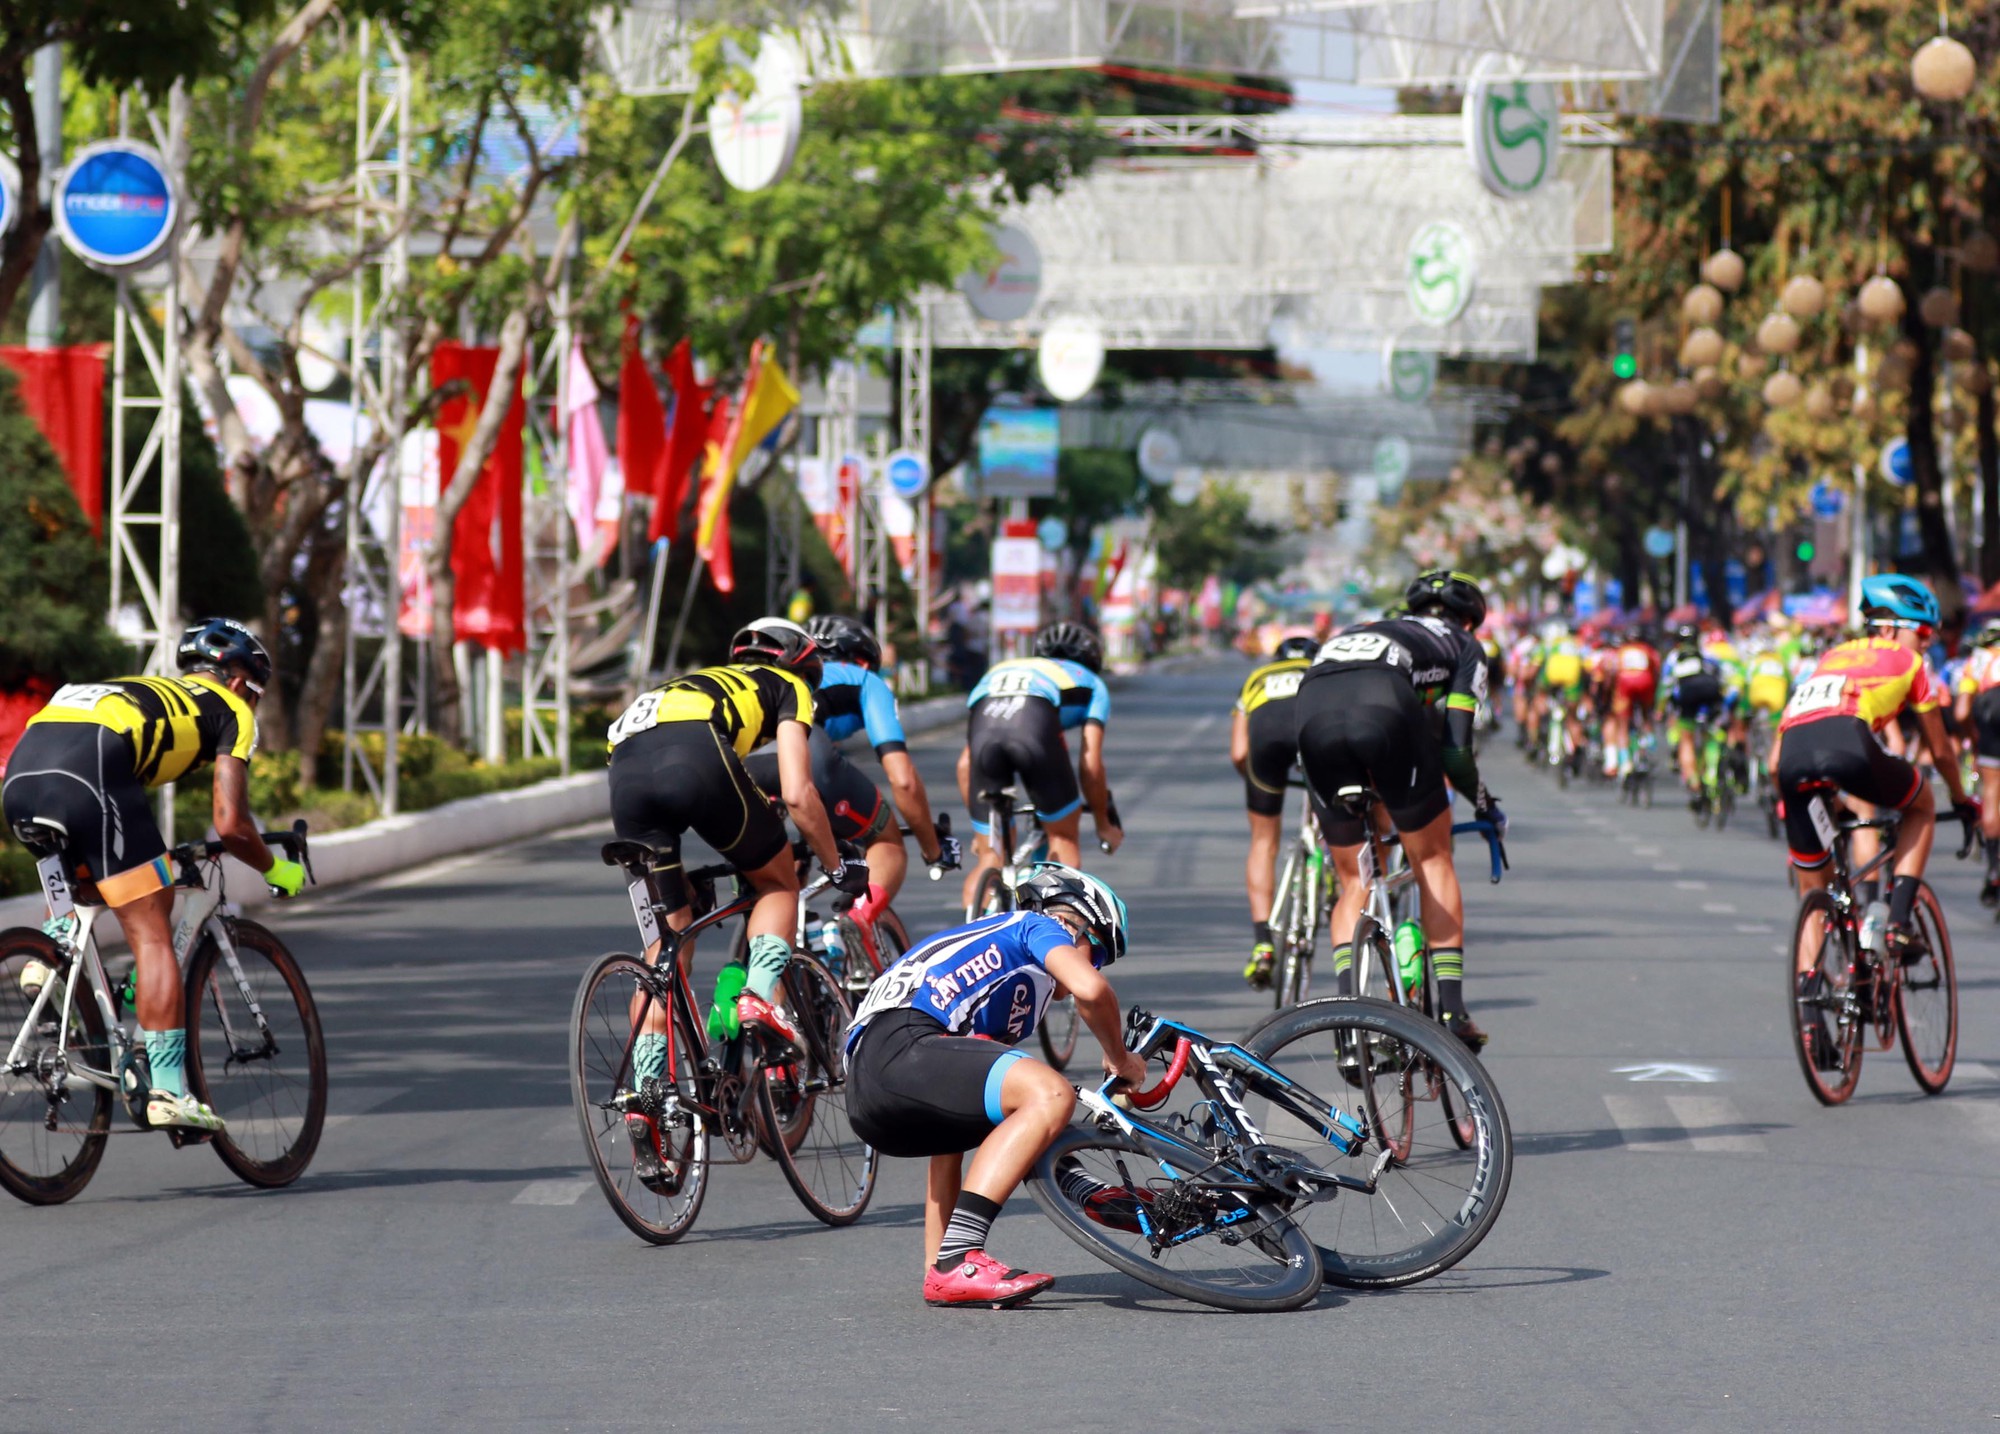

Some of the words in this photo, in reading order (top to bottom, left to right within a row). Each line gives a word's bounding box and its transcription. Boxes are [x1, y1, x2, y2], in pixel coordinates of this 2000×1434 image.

[47, 870, 66, 902] 72
[639, 896, 653, 929] 73
[954, 943, 1003, 987] THƠ
[861, 971, 914, 1014] 105
